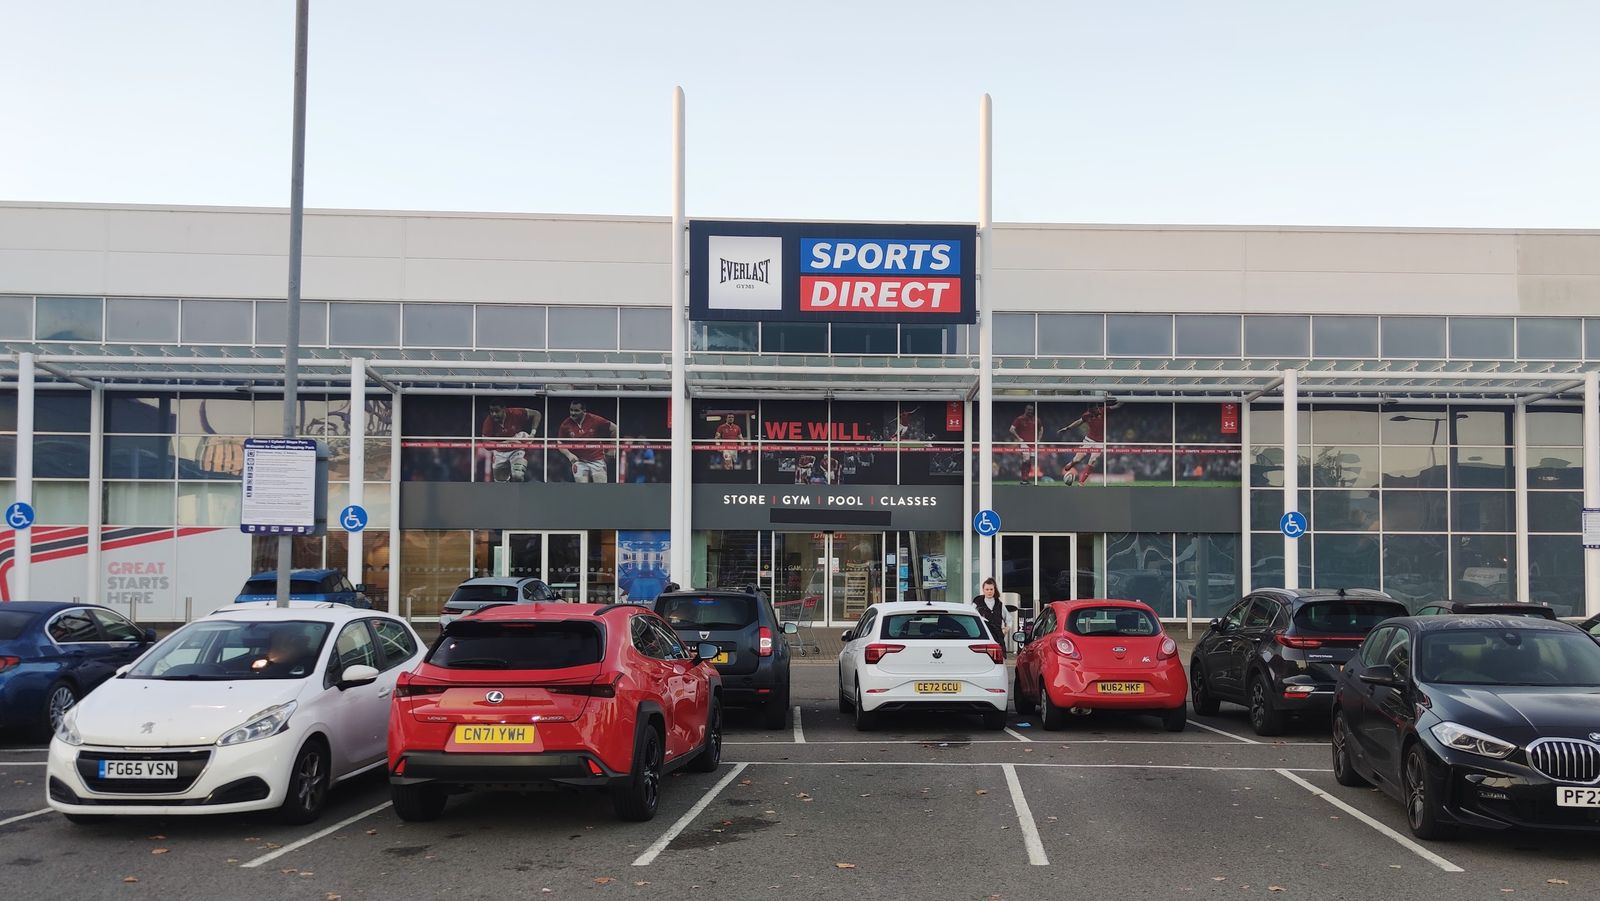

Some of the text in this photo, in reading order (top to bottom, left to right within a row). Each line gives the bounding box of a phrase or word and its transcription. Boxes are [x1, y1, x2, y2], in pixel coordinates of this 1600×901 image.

[810, 242, 952, 271] SPORTS
[720, 257, 770, 284] EVERLAST
[810, 281, 951, 308] DIRECT
[765, 421, 803, 440] WE
[723, 494, 937, 507] STORE GYM POOL CLASSES
[108, 561, 166, 575] GREAT
[107, 576, 169, 590] STARTS
[107, 592, 154, 604] HERE
[917, 682, 958, 691] CE72 GCU
[1101, 683, 1141, 691] WU62 HKF
[464, 728, 525, 741] CN71 YWH
[107, 762, 174, 776] FG65 VSN
